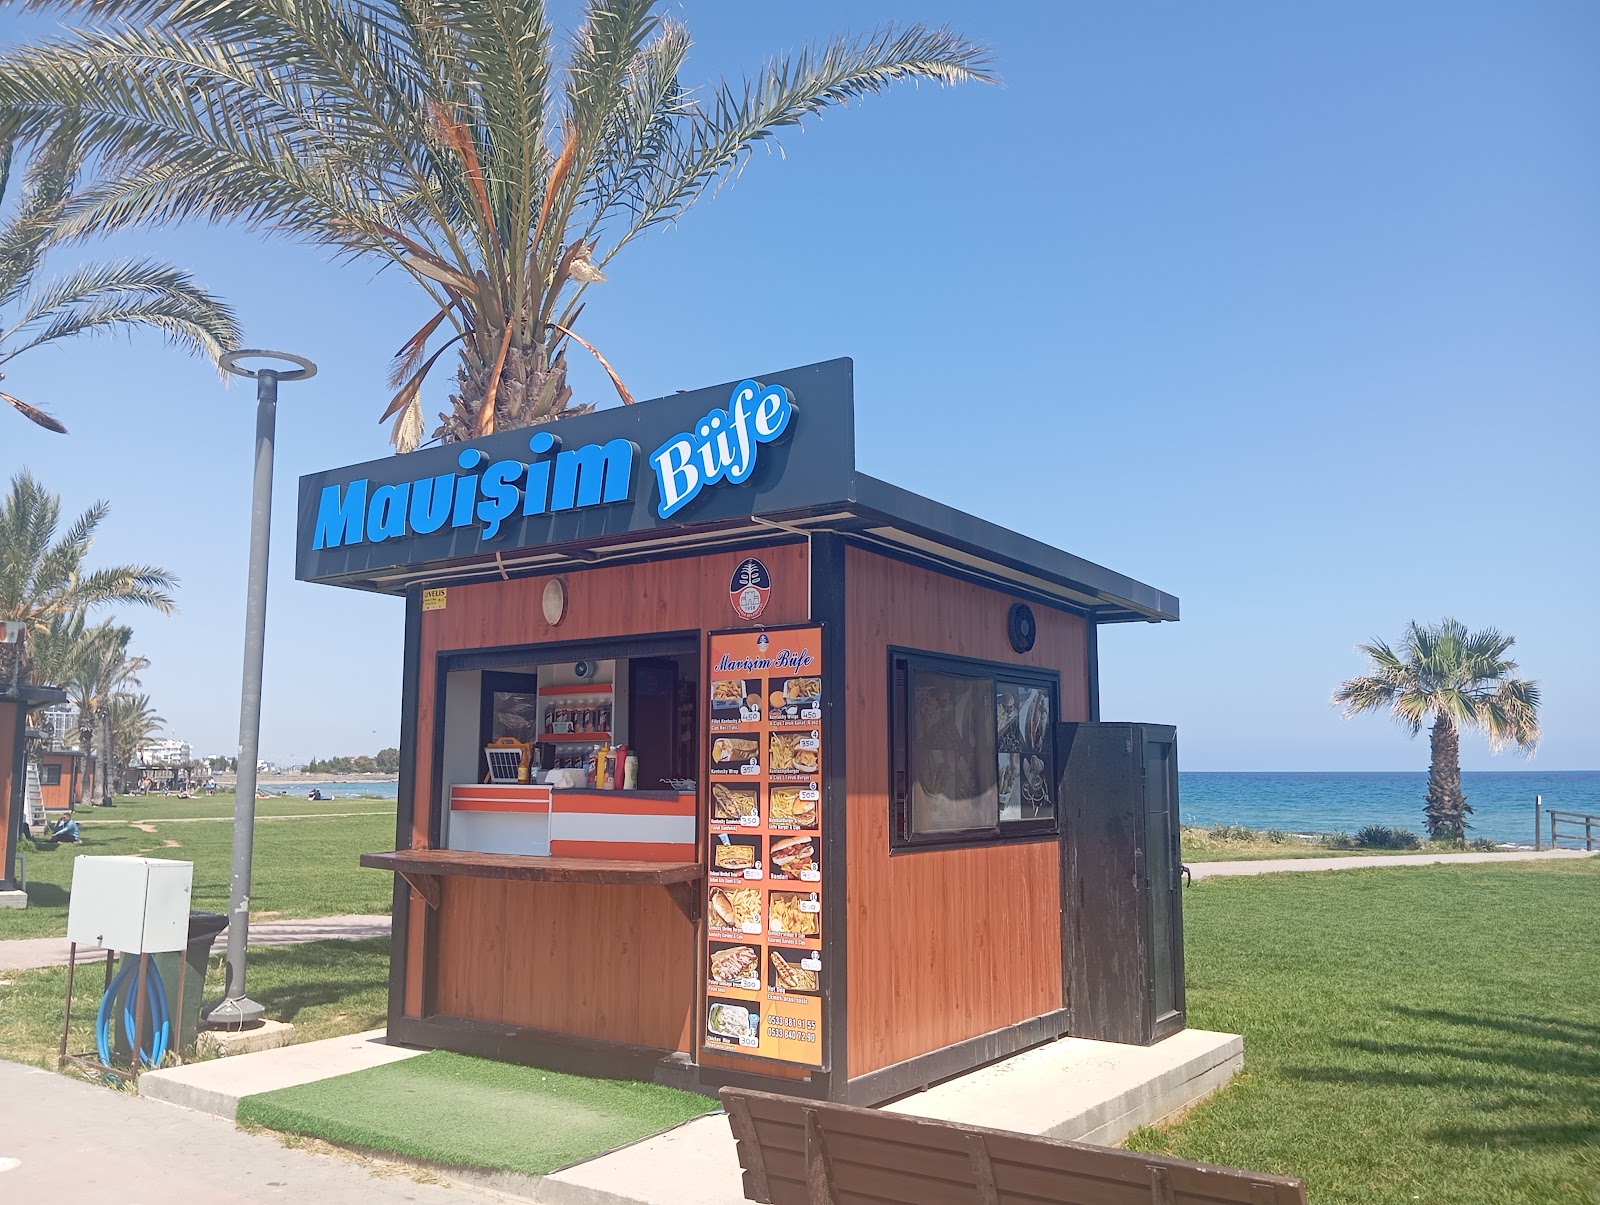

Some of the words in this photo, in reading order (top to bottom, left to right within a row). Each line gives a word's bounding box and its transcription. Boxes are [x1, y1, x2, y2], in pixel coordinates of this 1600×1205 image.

[649, 380, 792, 519] Büfe
[715, 653, 771, 672] Mavişim
[775, 648, 814, 675] Büfe
[801, 791, 815, 799] 500
[741, 817, 757, 825] 350
[768, 1015, 783, 1026] 0533
[784, 1016, 796, 1027] 881
[797, 1019, 806, 1029] 91
[807, 1020, 816, 1030] 55
[741, 1037, 756, 1045] 300
[767, 1027, 783, 1038] 0533
[784, 1029, 796, 1040] 840
[797, 1031, 806, 1041] 72
[807, 1032, 816, 1043] 90
